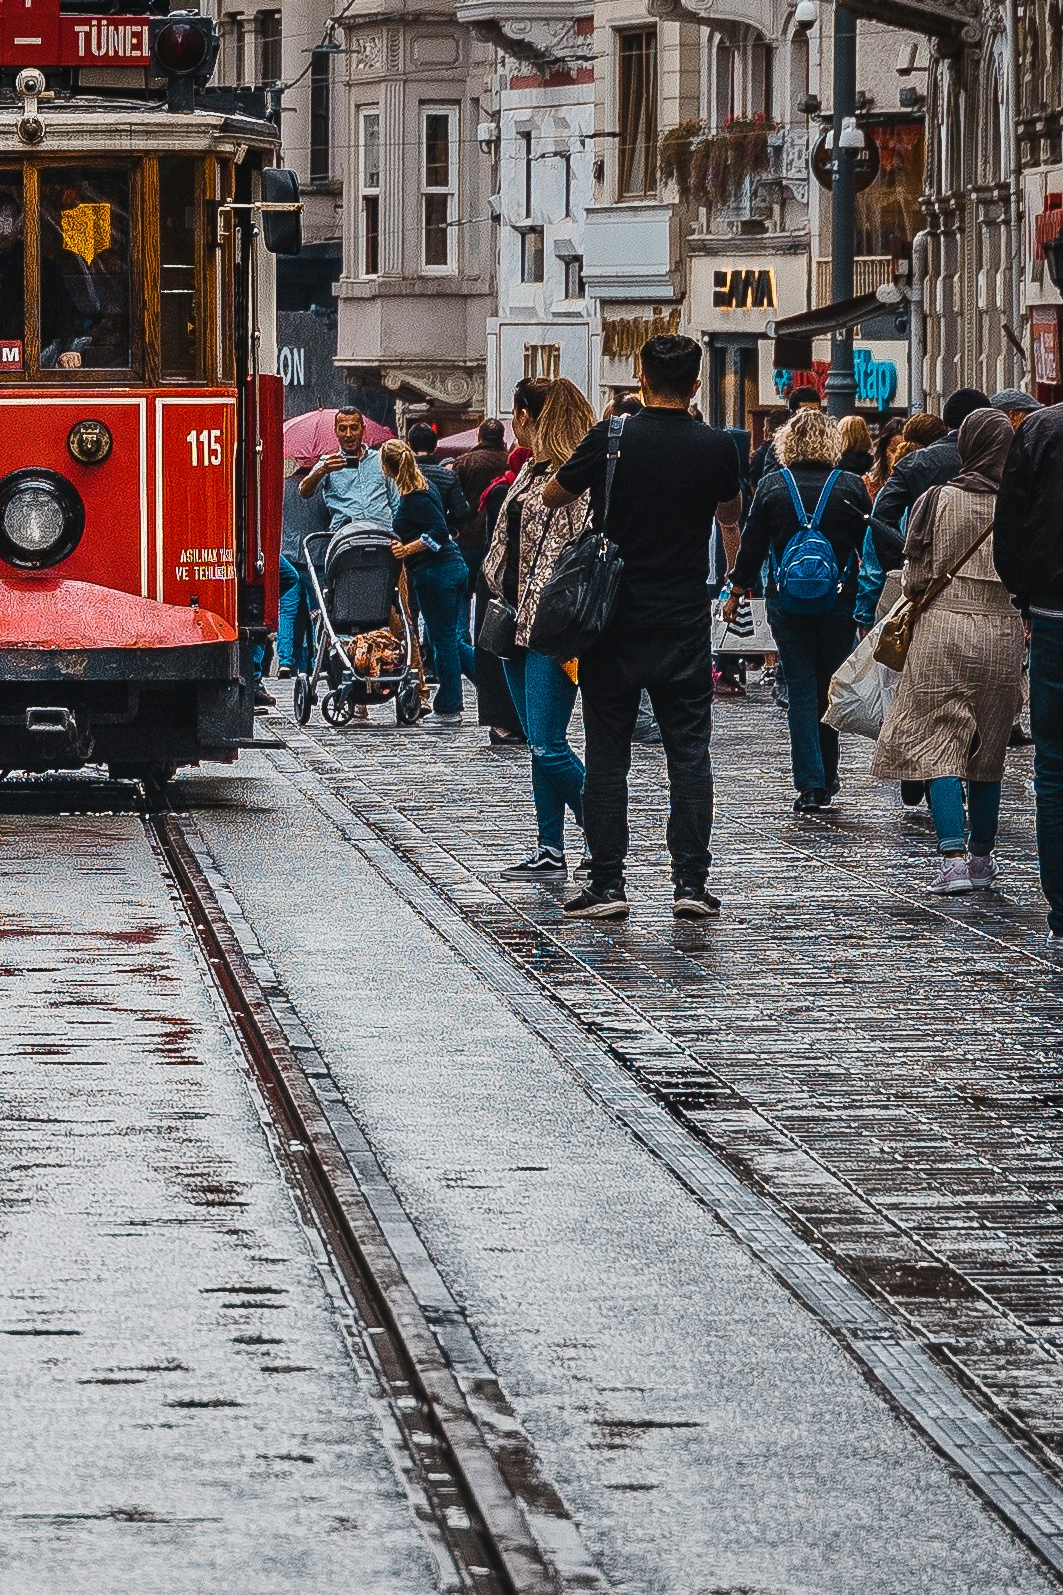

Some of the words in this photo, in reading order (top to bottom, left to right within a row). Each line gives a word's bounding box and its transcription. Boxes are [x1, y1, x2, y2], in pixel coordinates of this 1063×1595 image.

[186, 429, 222, 467] 115
[179, 548, 218, 563] ASILMAK
[175, 566, 190, 581] VE
